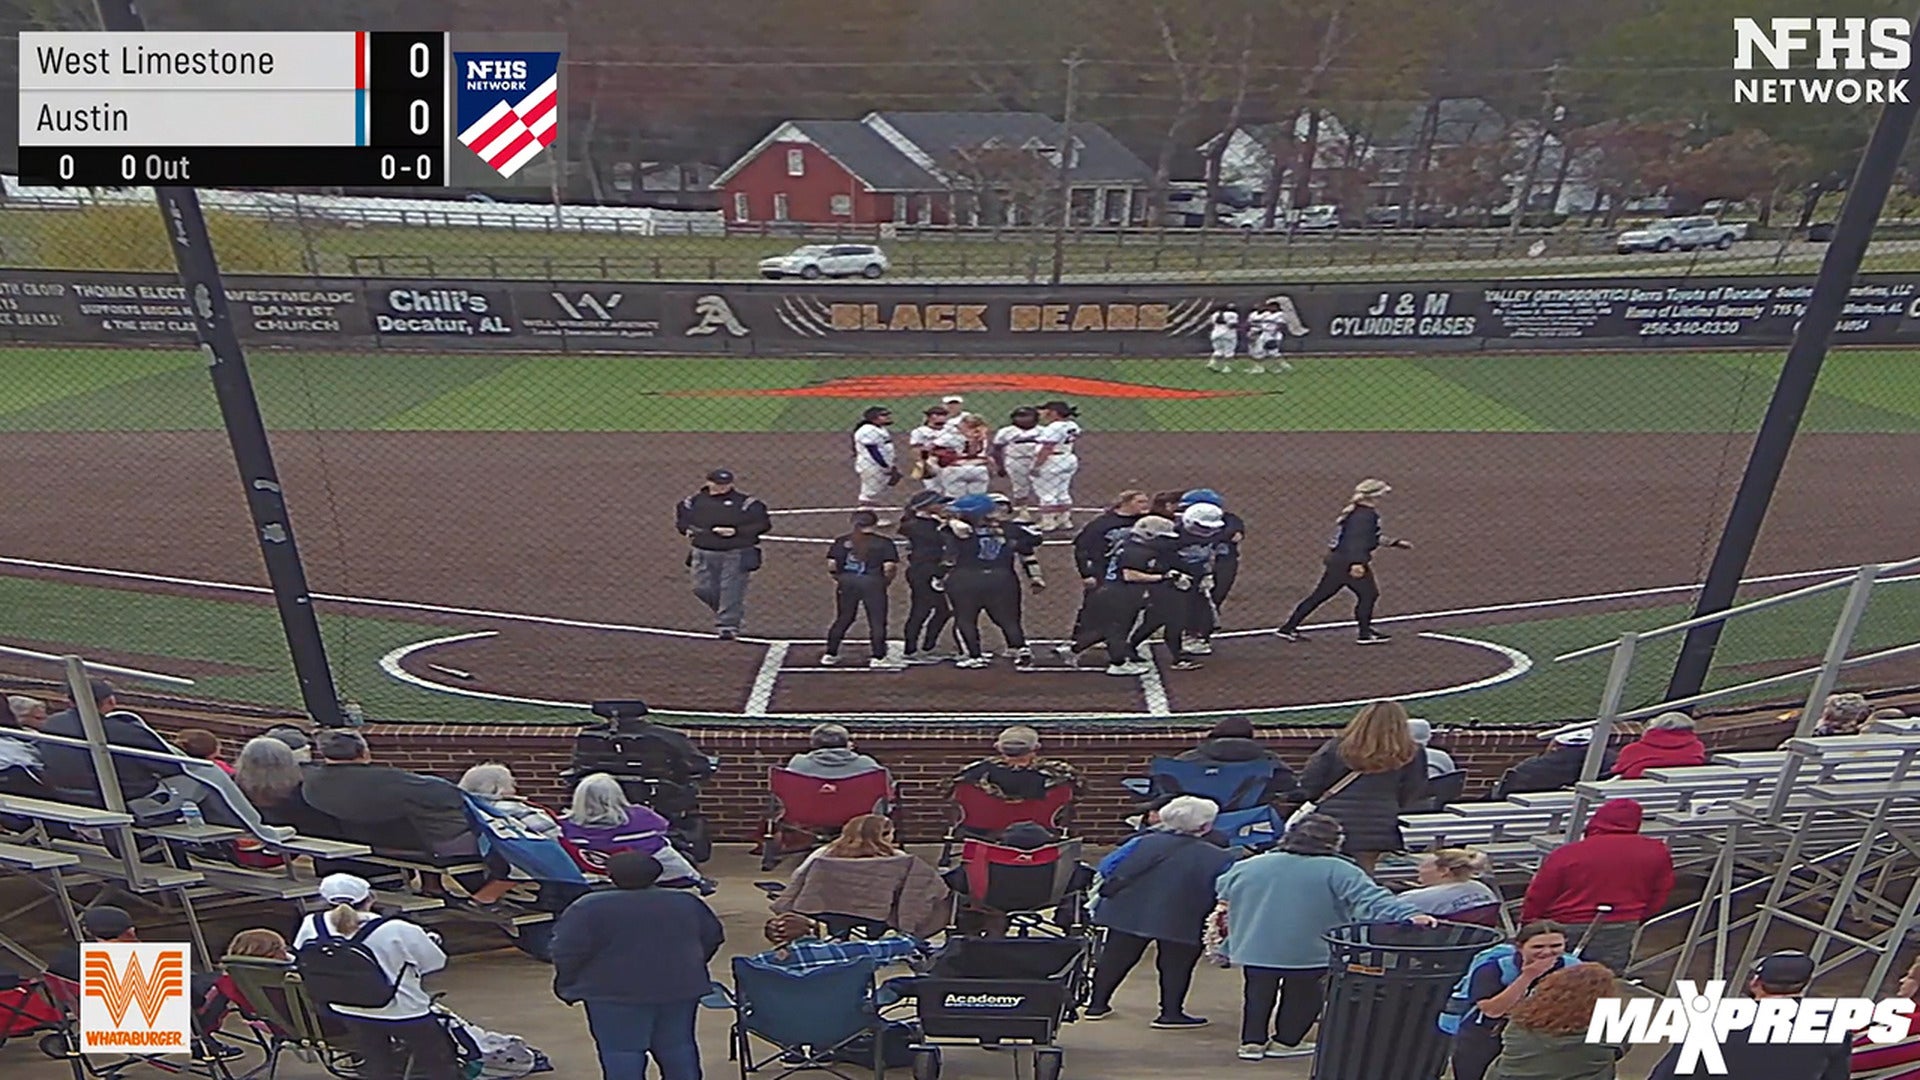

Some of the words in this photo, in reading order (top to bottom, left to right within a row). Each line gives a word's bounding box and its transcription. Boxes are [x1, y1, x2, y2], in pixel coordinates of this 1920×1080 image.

[72, 284, 138, 299] THOMAS
[140, 286, 187, 300] ELECT
[224, 290, 355, 303] WESTMEADE
[1485, 289, 1534, 302] VALLEY
[1667, 288, 1707, 304] Toyota
[1707, 288, 1724, 301] of
[1723, 287, 1773, 301] Decatur
[389, 289, 488, 313] Chili's
[1368, 293, 1389, 316] J
[1394, 293, 1416, 316] &
[1423, 293, 1450, 316] M
[252, 305, 335, 317] BAPTIST
[831, 304, 989, 332] BLACK
[1010, 304, 1171, 331] BEARS
[1624, 306, 1658, 318] Home
[1671, 305, 1714, 318] Lifetime
[1715, 304, 1765, 320] Warranty
[254, 320, 341, 332] CHURCH
[376, 315, 474, 336] Decatur,
[479, 316, 512, 333] AL
[1329, 317, 1415, 336] CYLINDER
[1418, 317, 1478, 336] GASES
[944, 994, 1025, 1006] Academy
